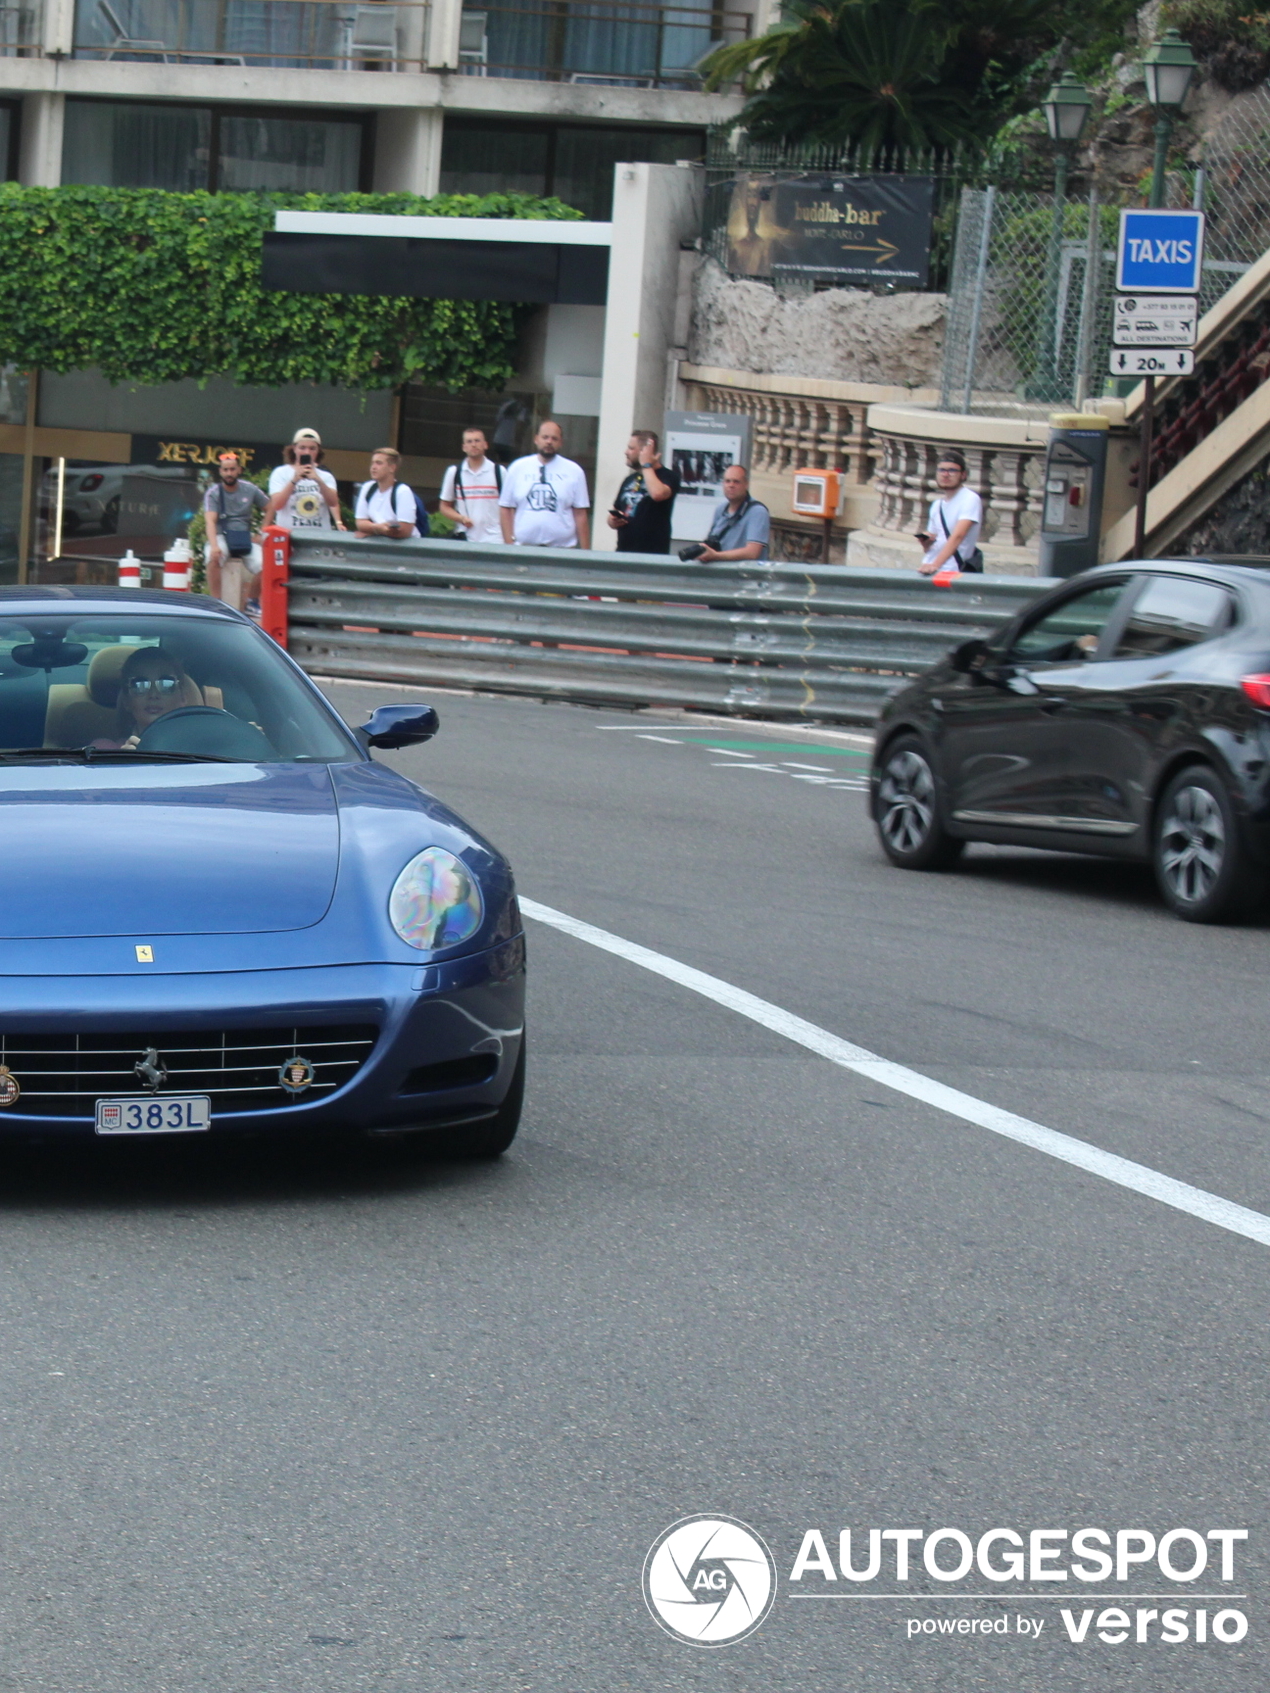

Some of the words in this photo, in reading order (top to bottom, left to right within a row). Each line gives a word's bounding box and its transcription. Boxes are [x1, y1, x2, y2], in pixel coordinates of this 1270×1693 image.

[1128, 239, 1192, 264] TAXIS
[1136, 335, 1188, 343] DESTINATIONS
[104, 1117, 118, 1125] MC
[126, 1102, 203, 1129] 383L
